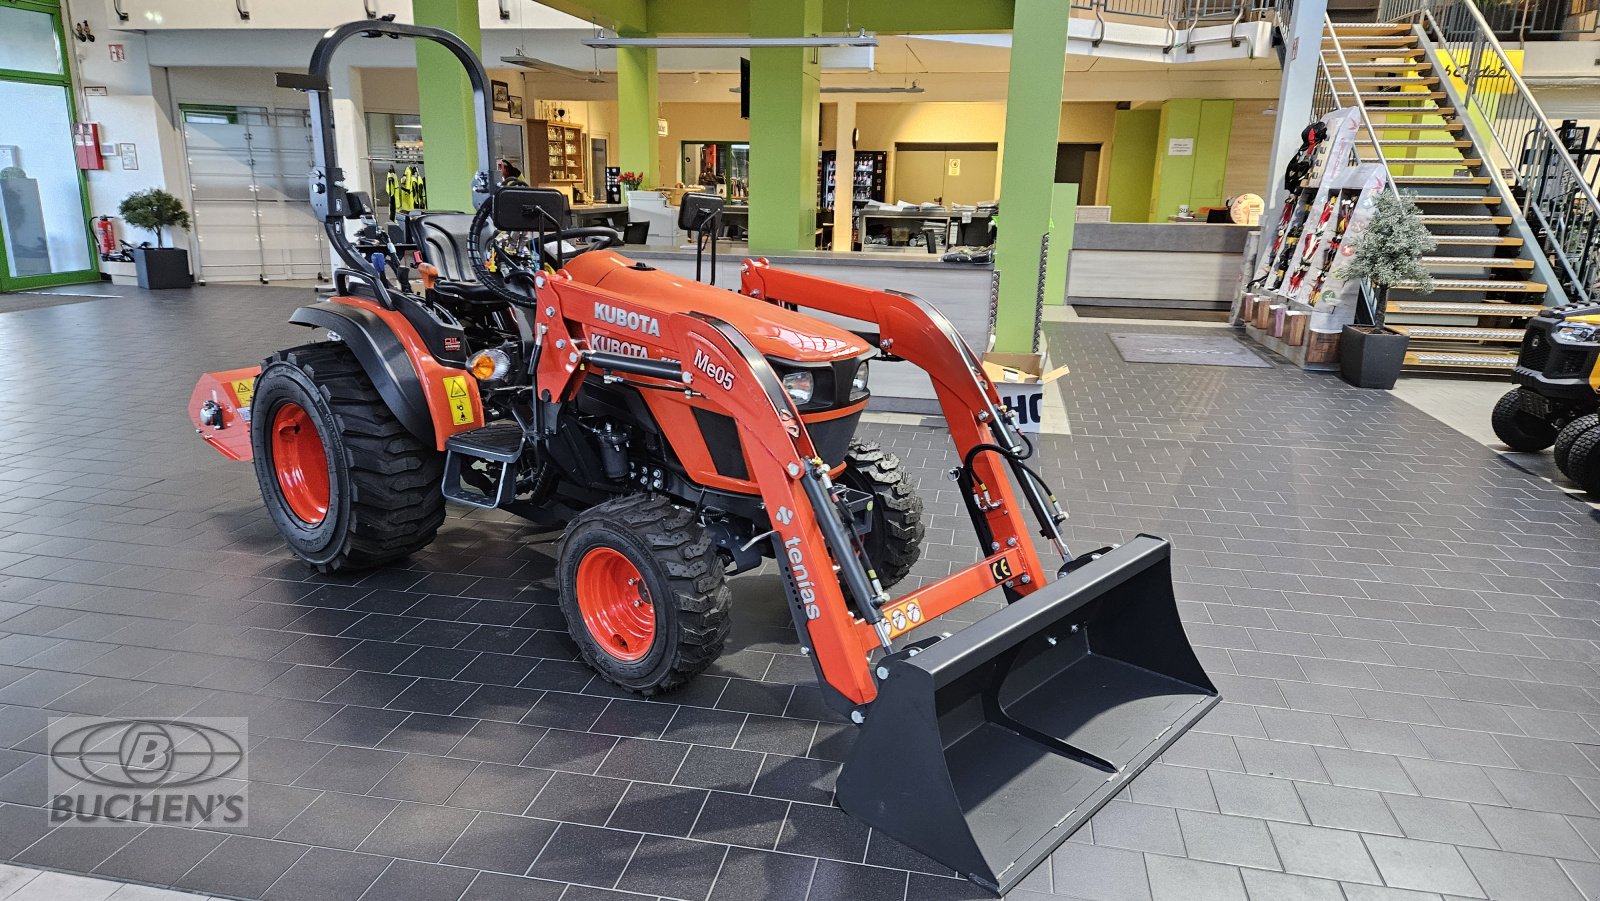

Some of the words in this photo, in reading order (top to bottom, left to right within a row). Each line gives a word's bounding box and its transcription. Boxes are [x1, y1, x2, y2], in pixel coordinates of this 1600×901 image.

[594, 301, 660, 337] KUBOTA
[591, 333, 648, 359] KUBOTA
[694, 349, 735, 390] Me05
[785, 536, 820, 620] tenias
